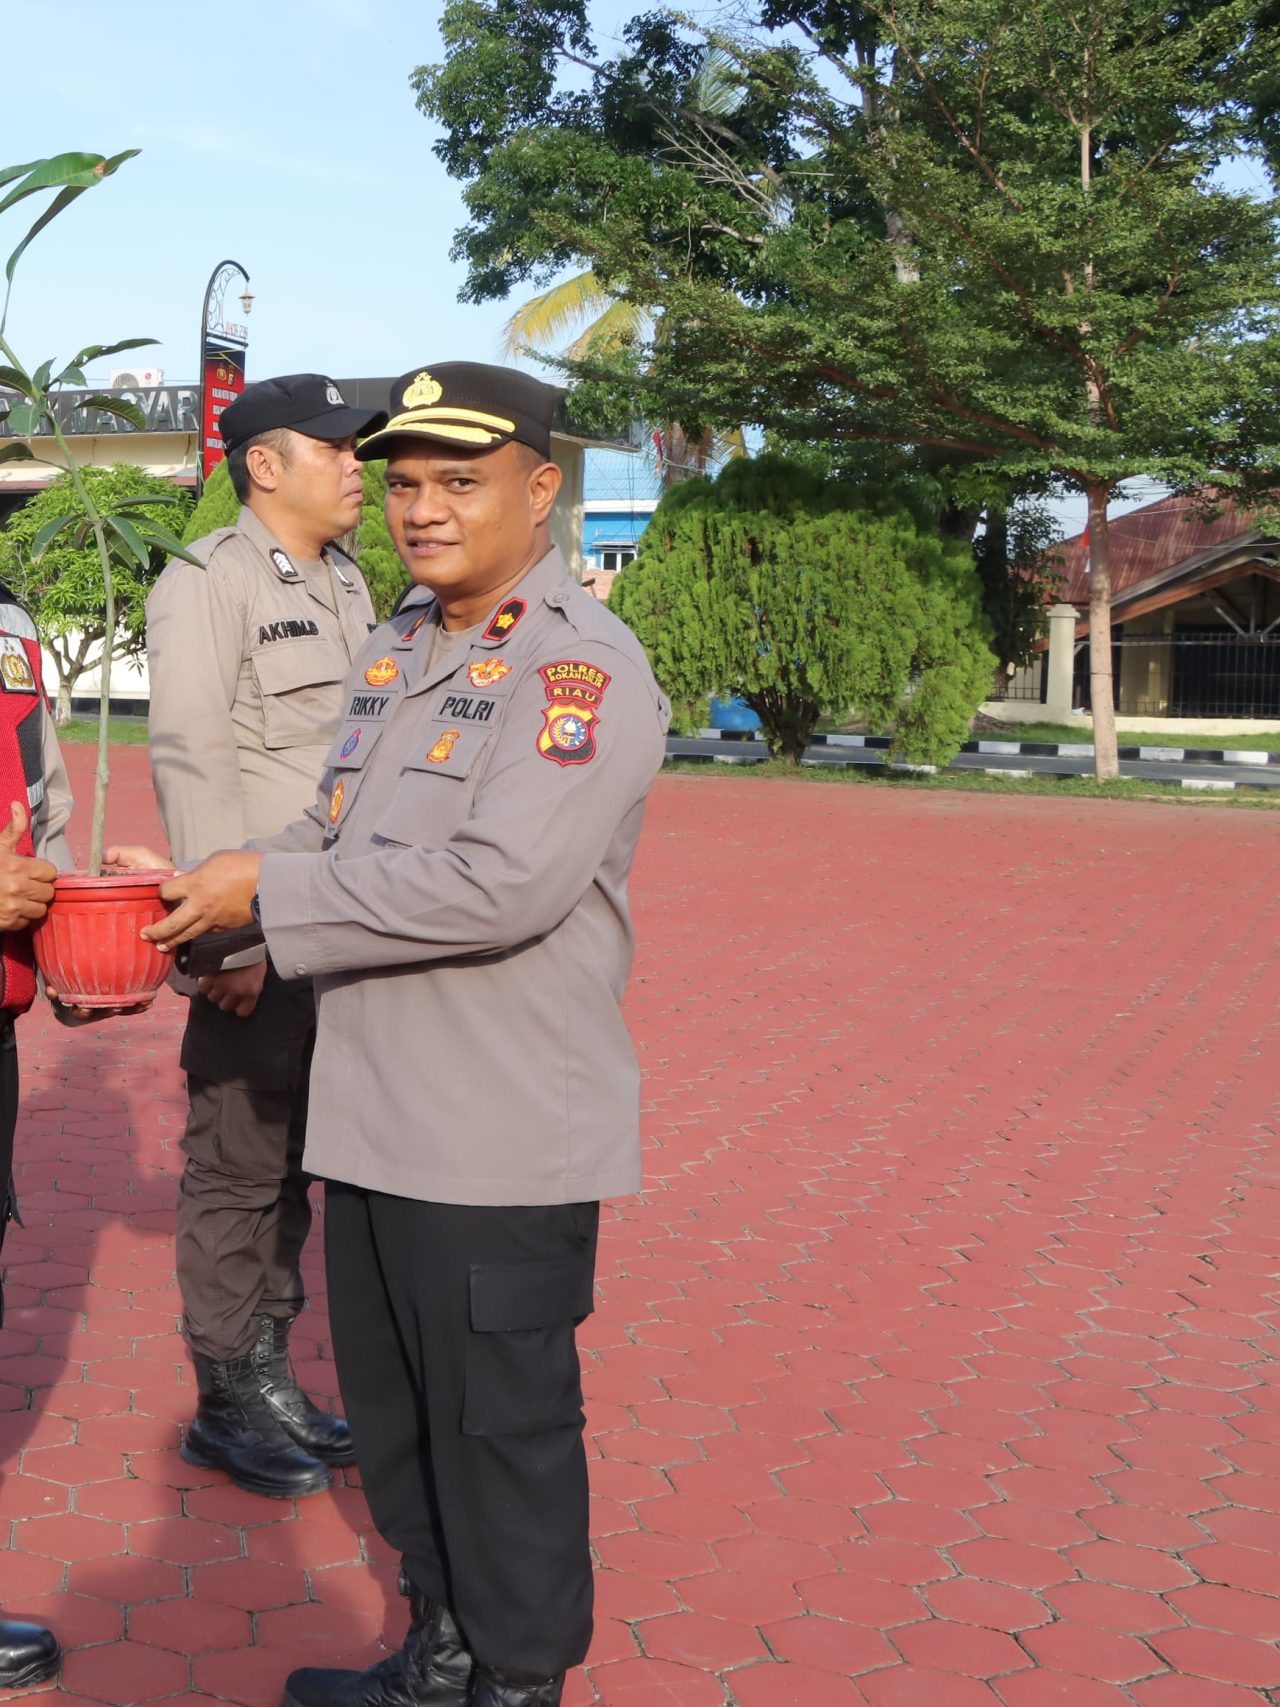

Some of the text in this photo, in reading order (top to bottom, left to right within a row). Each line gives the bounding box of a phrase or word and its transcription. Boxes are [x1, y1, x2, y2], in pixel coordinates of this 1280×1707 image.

[546, 663, 605, 683] POLRES
[550, 671, 581, 682] ROKAN
[553, 687, 596, 702] RIAU
[349, 696, 390, 716] RIKKY
[438, 696, 496, 721] POLRI
